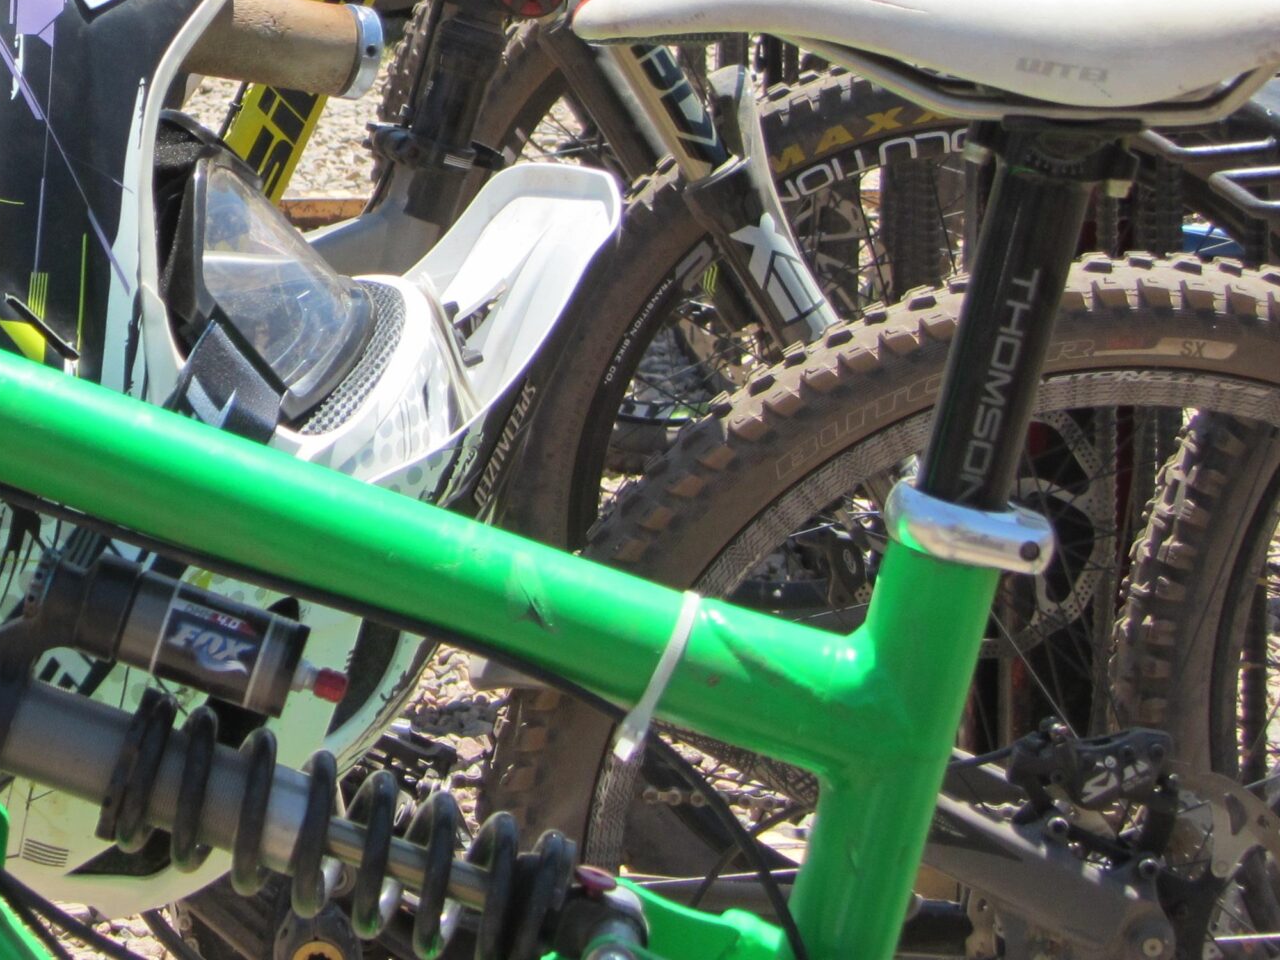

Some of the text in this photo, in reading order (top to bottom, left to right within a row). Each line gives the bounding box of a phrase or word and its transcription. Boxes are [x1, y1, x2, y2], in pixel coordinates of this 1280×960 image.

[1016, 58, 1108, 82] WTB
[1180, 340, 1207, 359] SX
[474, 385, 536, 507] SPECIALIZED
[167, 622, 257, 661] FOX
